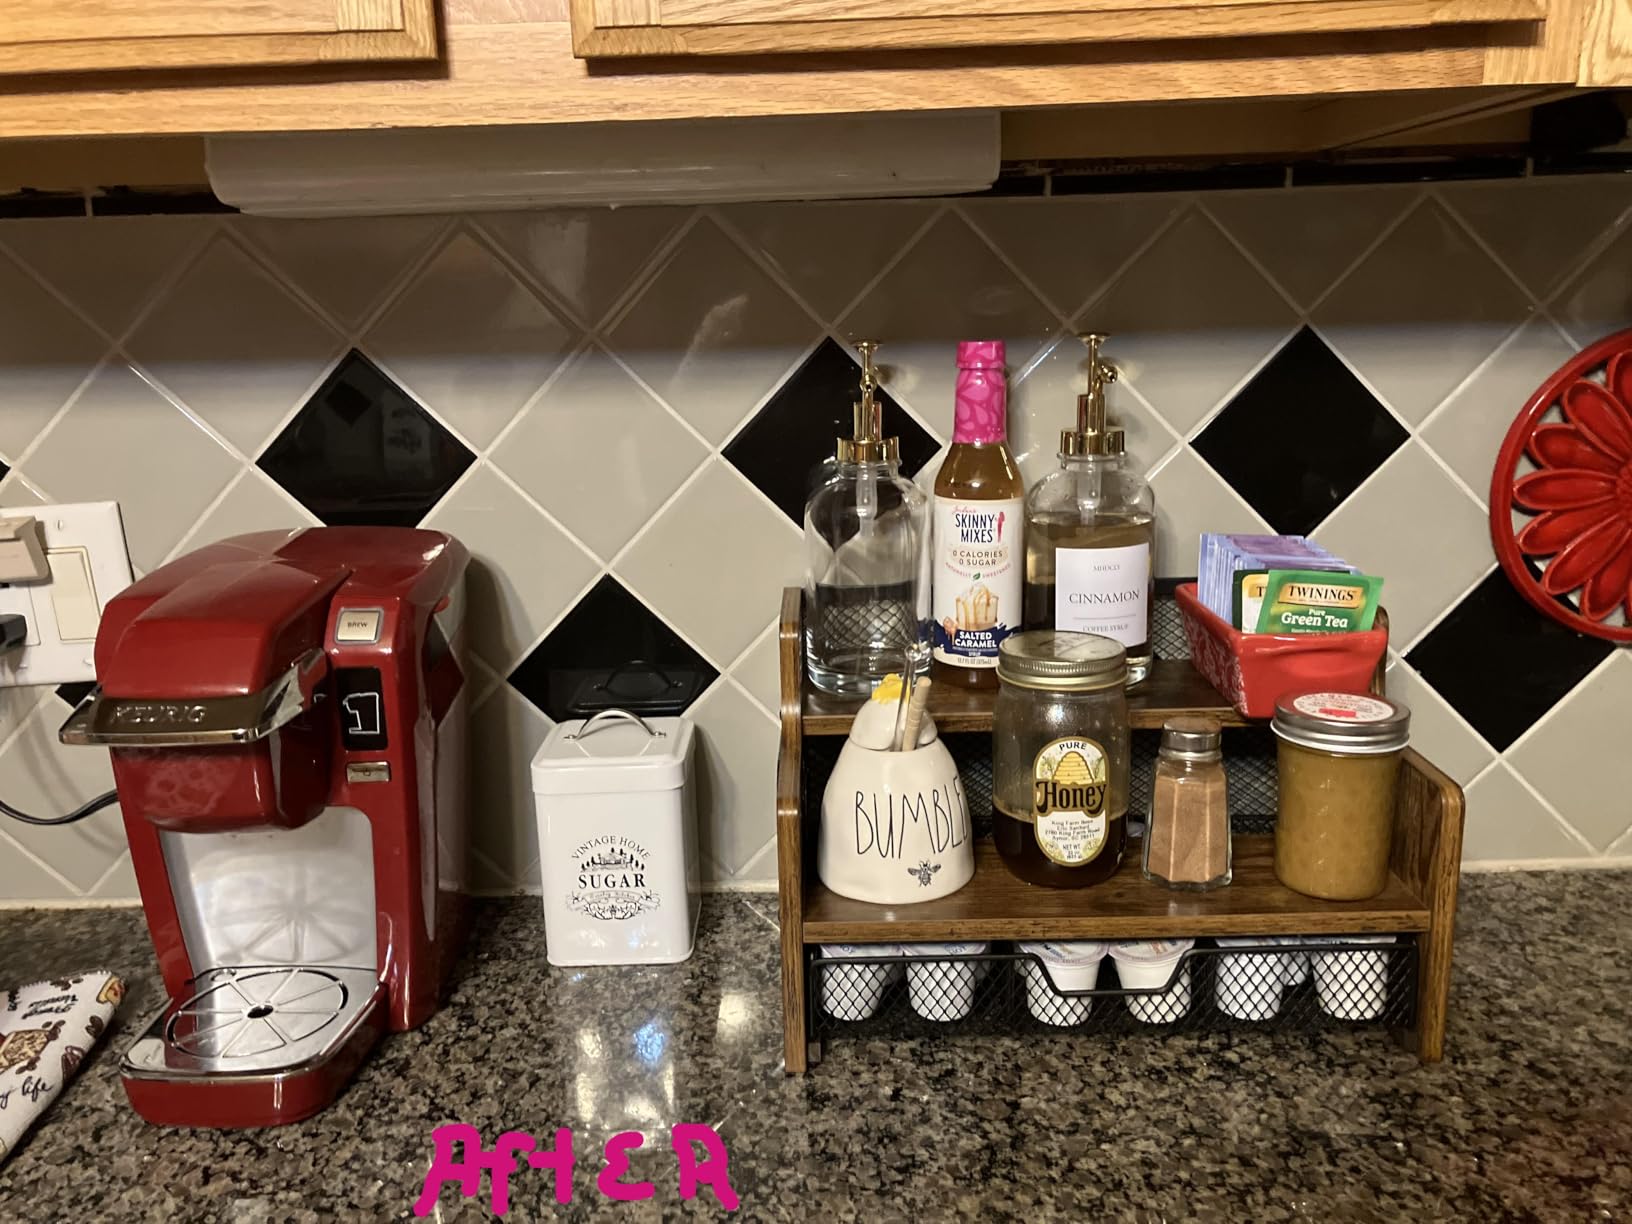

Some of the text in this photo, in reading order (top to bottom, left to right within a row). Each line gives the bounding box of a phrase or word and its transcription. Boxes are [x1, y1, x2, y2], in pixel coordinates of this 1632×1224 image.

[955, 513, 995, 528] SKINNY
[960, 529, 993, 543] MIXES
[960, 550, 1003, 558] CALORIES
[1069, 590, 1140, 604] CINNAMON
[1288, 585, 1354, 601] TWININGS
[1308, 608, 1326, 616] Pure
[1281, 612, 1348, 628] Green Tea
[959, 631, 992, 640] SALTED
[955, 639, 997, 648] CARAMEL
[109, 705, 206, 723] KEURIG
[1059, 742, 1087, 751] PURE
[1036, 781, 1107, 815] Honey
[571, 835, 652, 860] VINTAGE HOME
[578, 873, 646, 889] SUGAR
[22, 1075, 52, 1102] life
